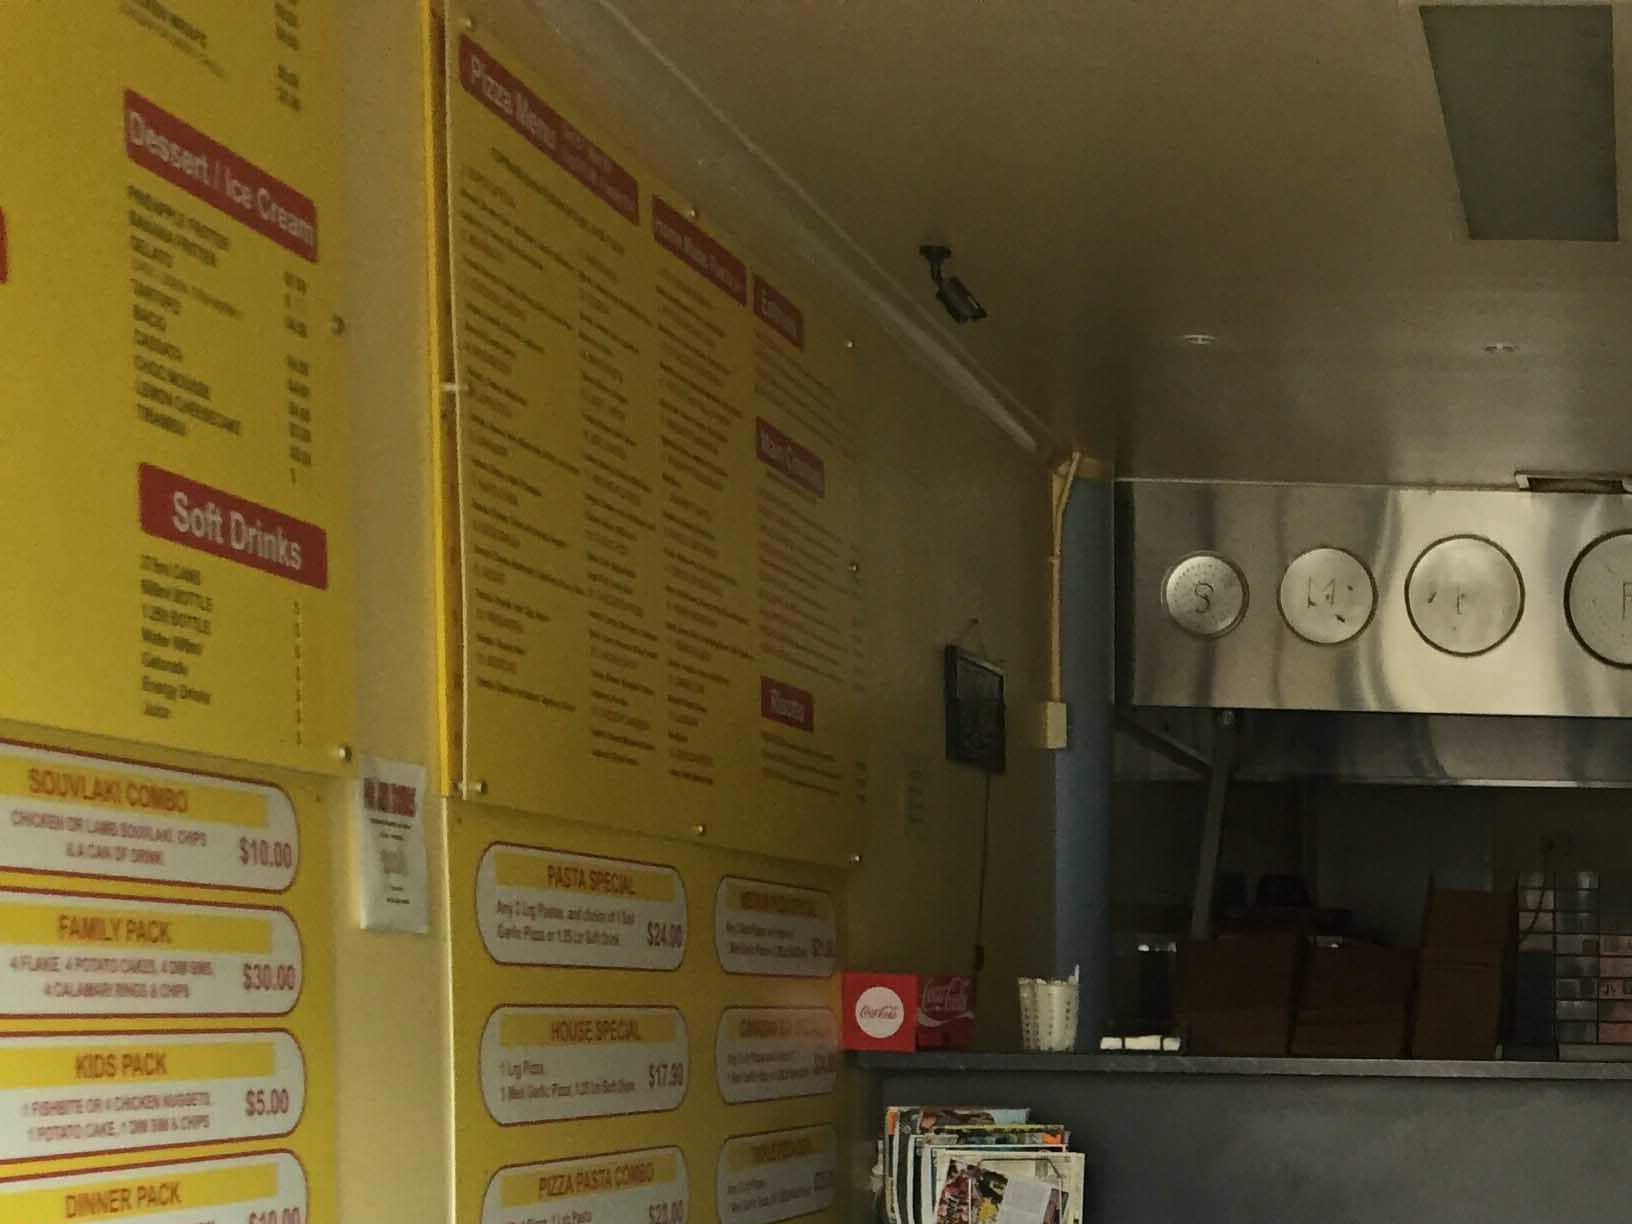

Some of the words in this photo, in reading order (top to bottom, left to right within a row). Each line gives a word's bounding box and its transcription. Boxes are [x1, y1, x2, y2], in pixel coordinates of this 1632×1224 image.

[128, 111, 209, 186] Dessert
[224, 164, 252, 210] Ice
[257, 187, 315, 252] Cream
[173, 490, 224, 544] Soft
[230, 511, 302, 570] Drinks
[29, 767, 121, 805] SOUVLAKI
[127, 783, 189, 814] COMBO
[239, 835, 293, 870] $10.00
[547, 863, 588, 890] PASTA
[590, 869, 637, 895] SPECIAL
[58, 914, 121, 942] FAMILY
[126, 917, 173, 944] PACK
[243, 962, 297, 992] $30.00
[551, 1020, 593, 1044] HOUSE
[595, 1017, 642, 1041] SPECIAL
[75, 1053, 117, 1080] KIDS
[122, 1051, 167, 1077] PACK
[245, 1088, 290, 1117] $5.00
[538, 1174, 575, 1201] PIZZA
[577, 1168, 612, 1192] PASTA
[614, 1162, 655, 1188] COMBO
[65, 1187, 133, 1219] DINNER
[137, 1182, 182, 1209] PACK
